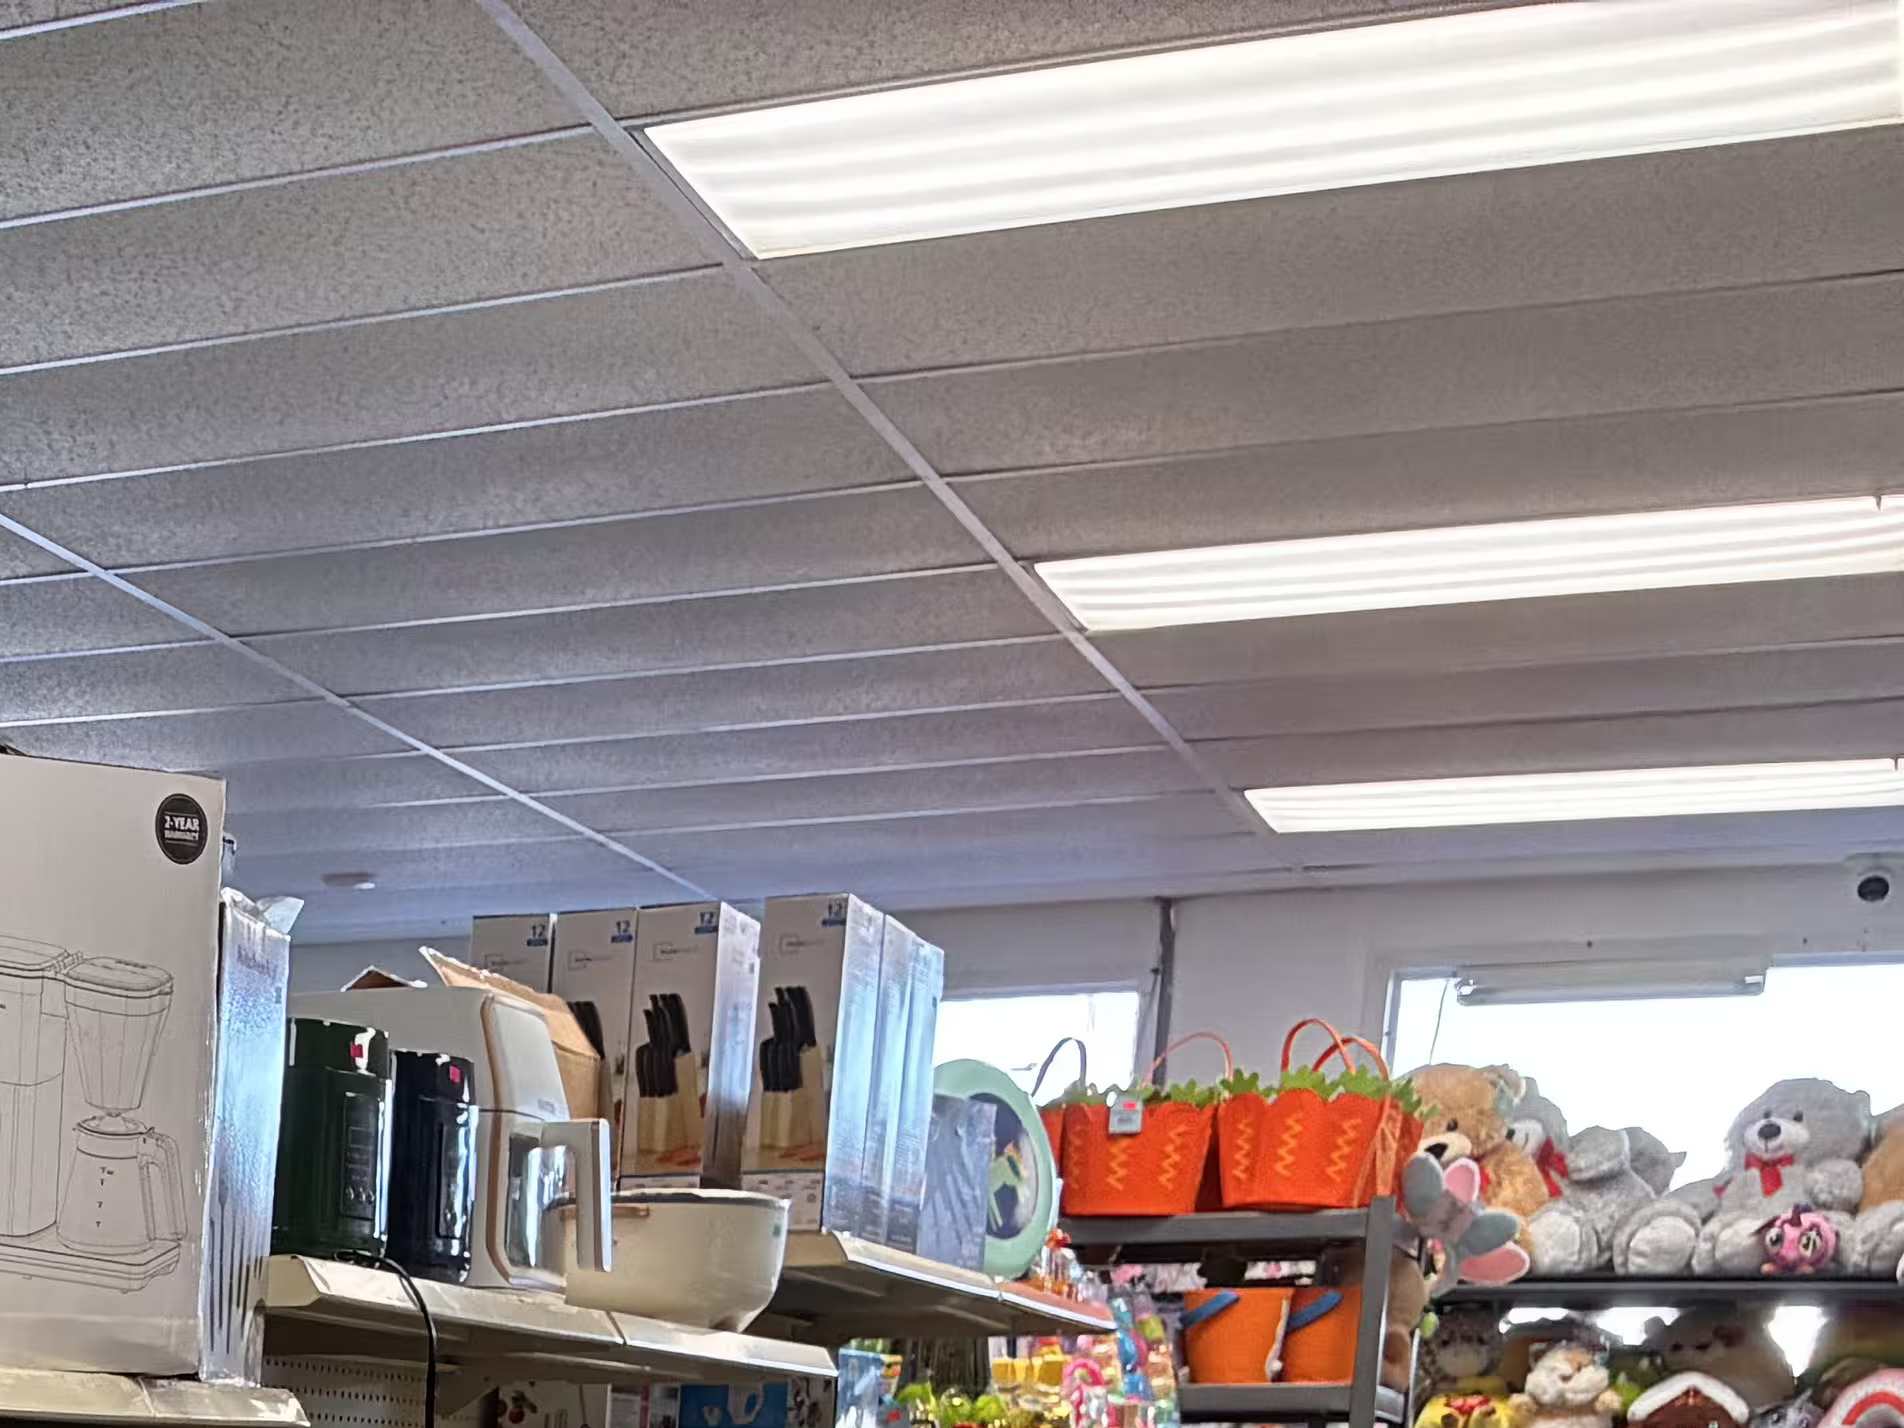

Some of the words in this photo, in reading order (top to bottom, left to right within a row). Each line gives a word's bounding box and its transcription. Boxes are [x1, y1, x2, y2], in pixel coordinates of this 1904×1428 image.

[164, 814, 200, 834] 2-YEAR
[828, 904, 843, 917] 12
[699, 912, 714, 924] 12
[530, 925, 547, 937] 12
[615, 921, 630, 933] 12
